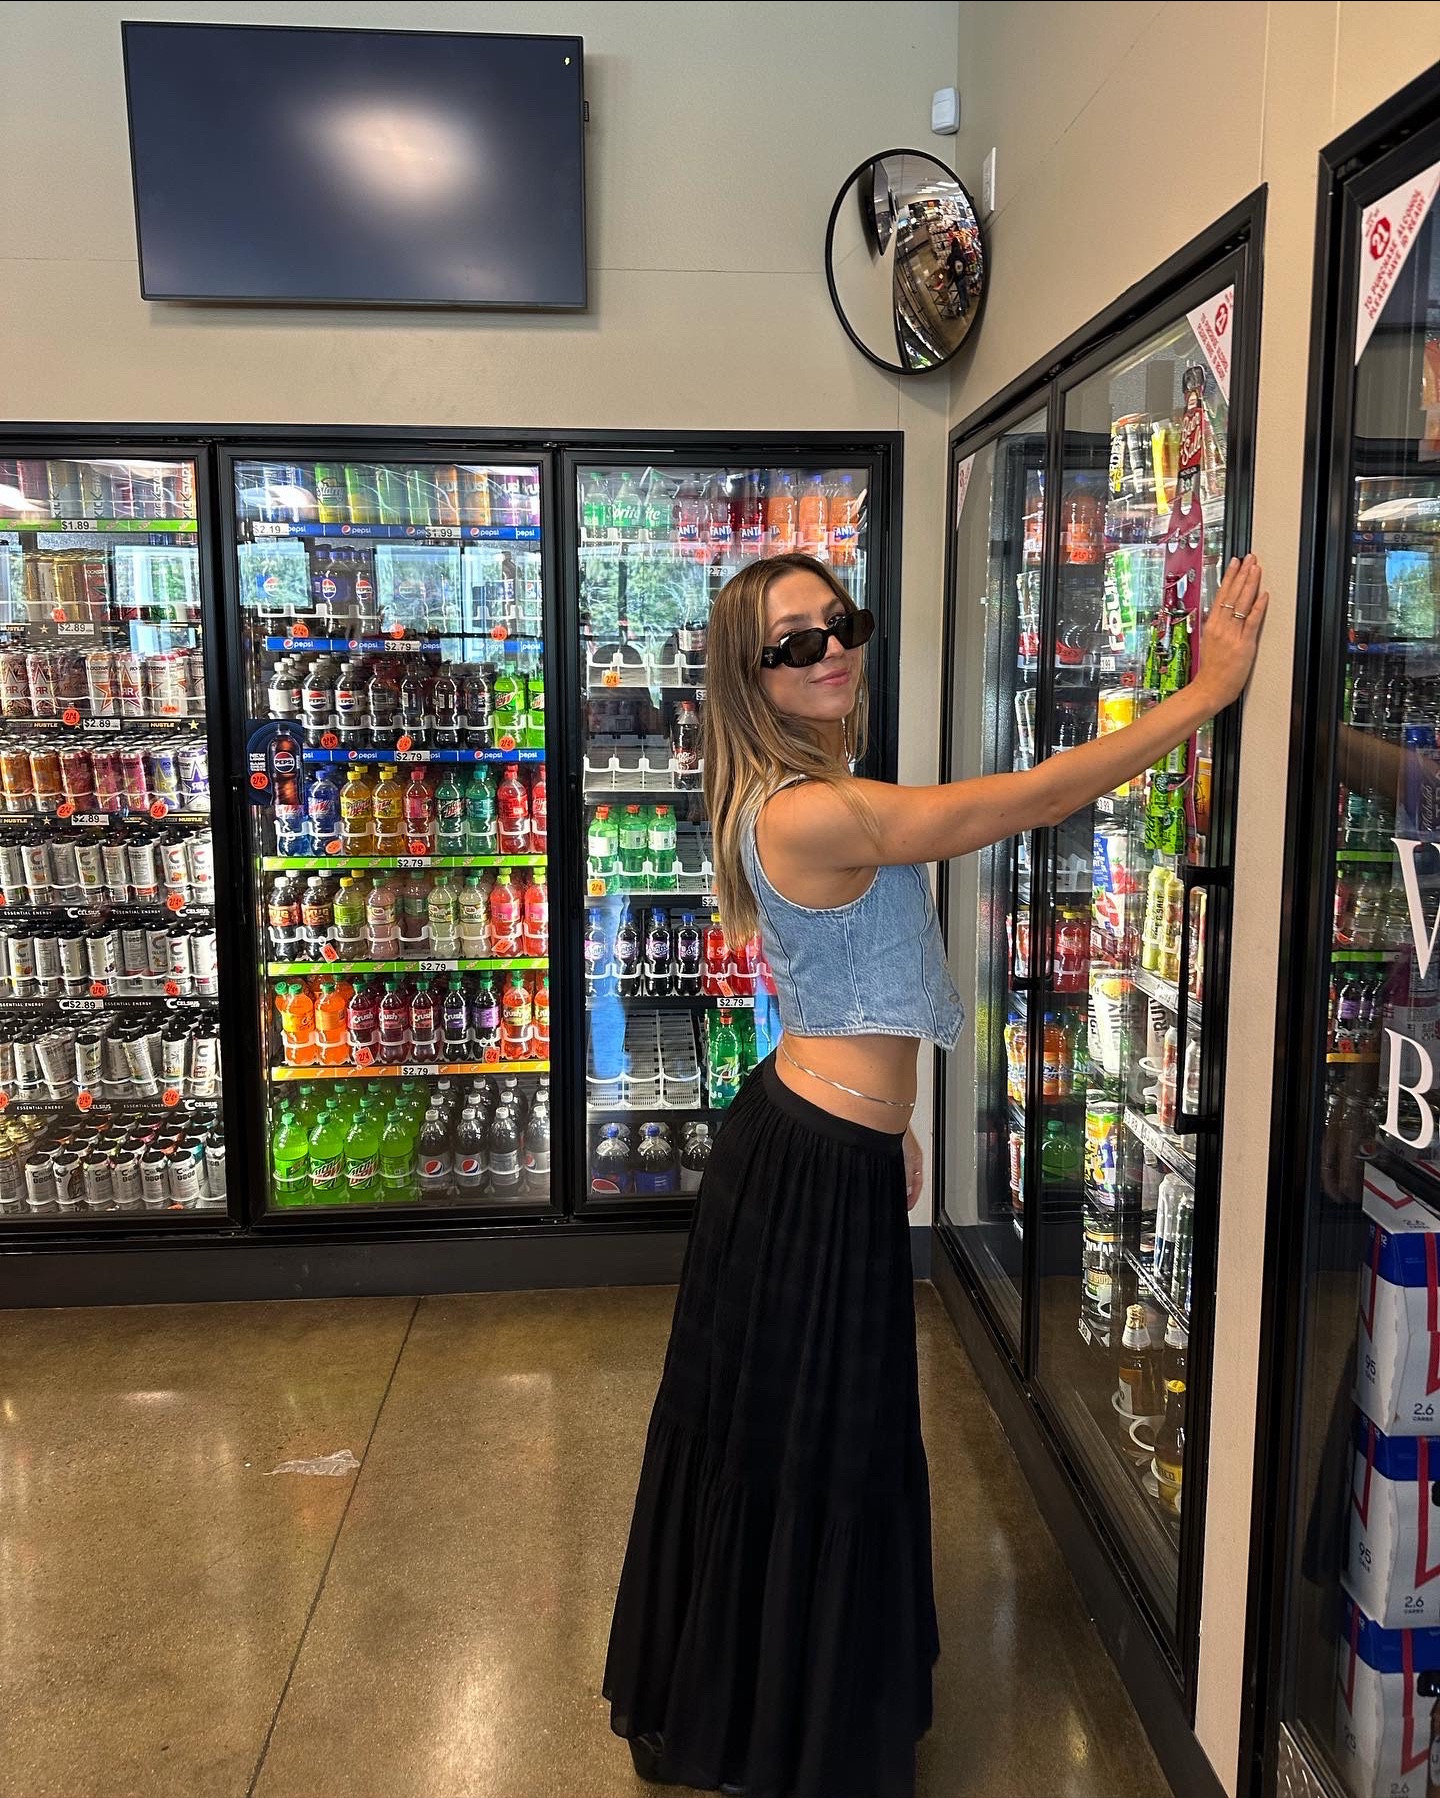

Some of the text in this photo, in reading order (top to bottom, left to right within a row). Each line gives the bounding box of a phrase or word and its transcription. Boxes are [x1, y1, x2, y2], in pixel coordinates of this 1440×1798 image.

[1372, 223, 1390, 255] 21
[1364, 188, 1422, 310] TO PURCHASE ALCOHOL
[1368, 196, 1427, 320] PLEASE HAVE ID READY
[61, 521, 90, 530] $1.89
[253, 525, 281, 534] $2.19
[426, 527, 453, 537] $1.99
[59, 624, 86, 632] $2.89
[385, 642, 411, 651] $2.79
[84, 719, 111, 728] $2.89
[396, 752, 422, 761] $2.79
[72, 815, 100, 823] $2.89
[397, 859, 423, 868] $2.79
[703, 898, 717, 906] $2.
[1156, 893, 1165, 913] SALT
[421, 963, 446, 971] $2.79
[69, 1000, 96, 1009] $2.89
[719, 999, 744, 1007] $2.79
[355, 1012, 374, 1024] Crush
[414, 1012, 433, 1022] Crush
[445, 1012, 464, 1021] Crush
[402, 1067, 429, 1076] $2.79
[194, 1101, 218, 1109] CELSIUS
[1366, 1354, 1376, 1376] 95
[1414, 1402, 1435, 1416] 2.6
[1359, 1542, 1372, 1564] 95
[1404, 1595, 1424, 1609] 2.6
[1390, 1783, 1410, 1795] 2.6
